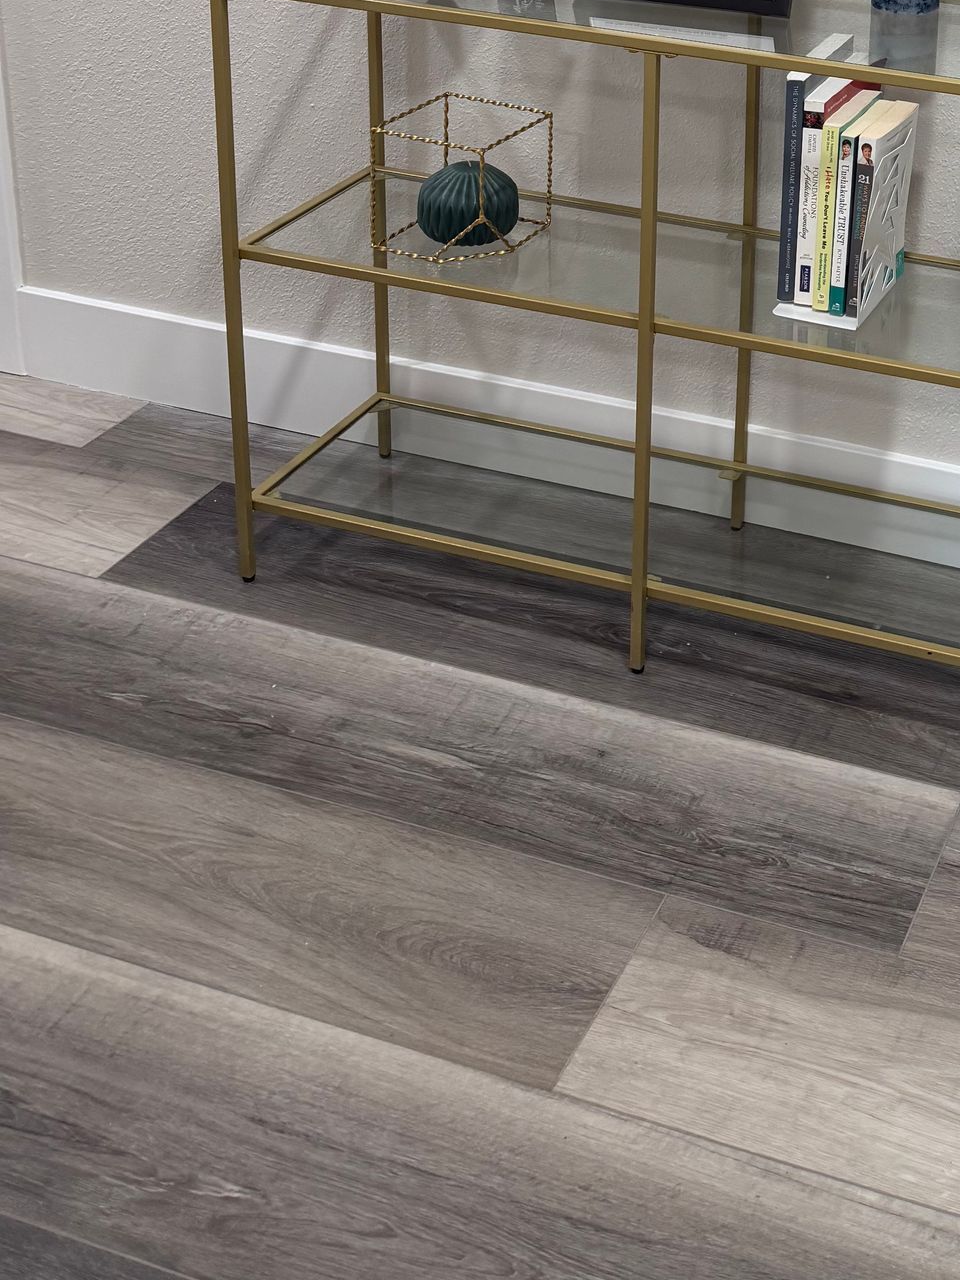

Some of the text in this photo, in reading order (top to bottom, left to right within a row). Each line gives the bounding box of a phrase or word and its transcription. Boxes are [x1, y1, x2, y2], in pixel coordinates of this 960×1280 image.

[825, 170, 834, 189] Hate
[858, 174, 870, 184] 21
[811, 167, 819, 219] FOUNDATIONS
[837, 165, 849, 245] Unshakeable TRUST
[862, 204, 867, 212] TO
[822, 241, 827, 249] Me
